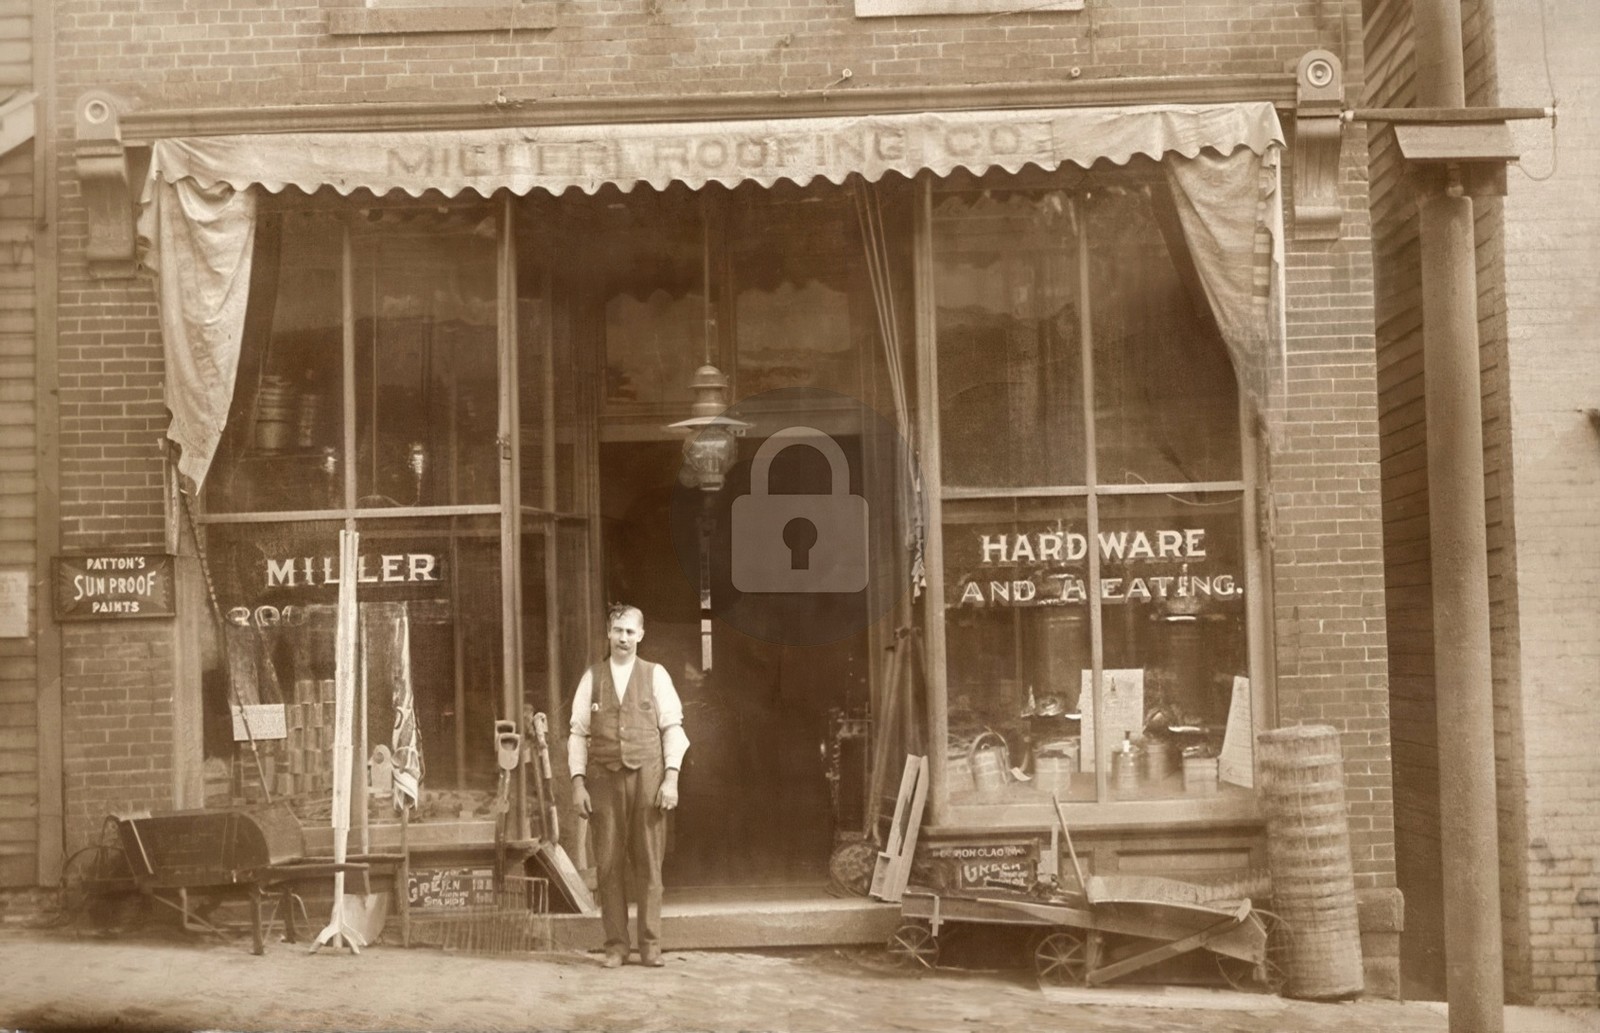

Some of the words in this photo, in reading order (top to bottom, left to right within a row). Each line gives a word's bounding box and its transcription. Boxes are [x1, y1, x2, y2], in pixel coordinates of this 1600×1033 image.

[980, 529, 1207, 562] HARDWARE
[86, 556, 146, 570] PATTON'S
[266, 553, 438, 587] MILLER
[73, 574, 105, 601] SUN
[109, 570, 157, 597] PROOF
[960, 579, 1036, 603] AND
[92, 601, 140, 613] PAINTS
